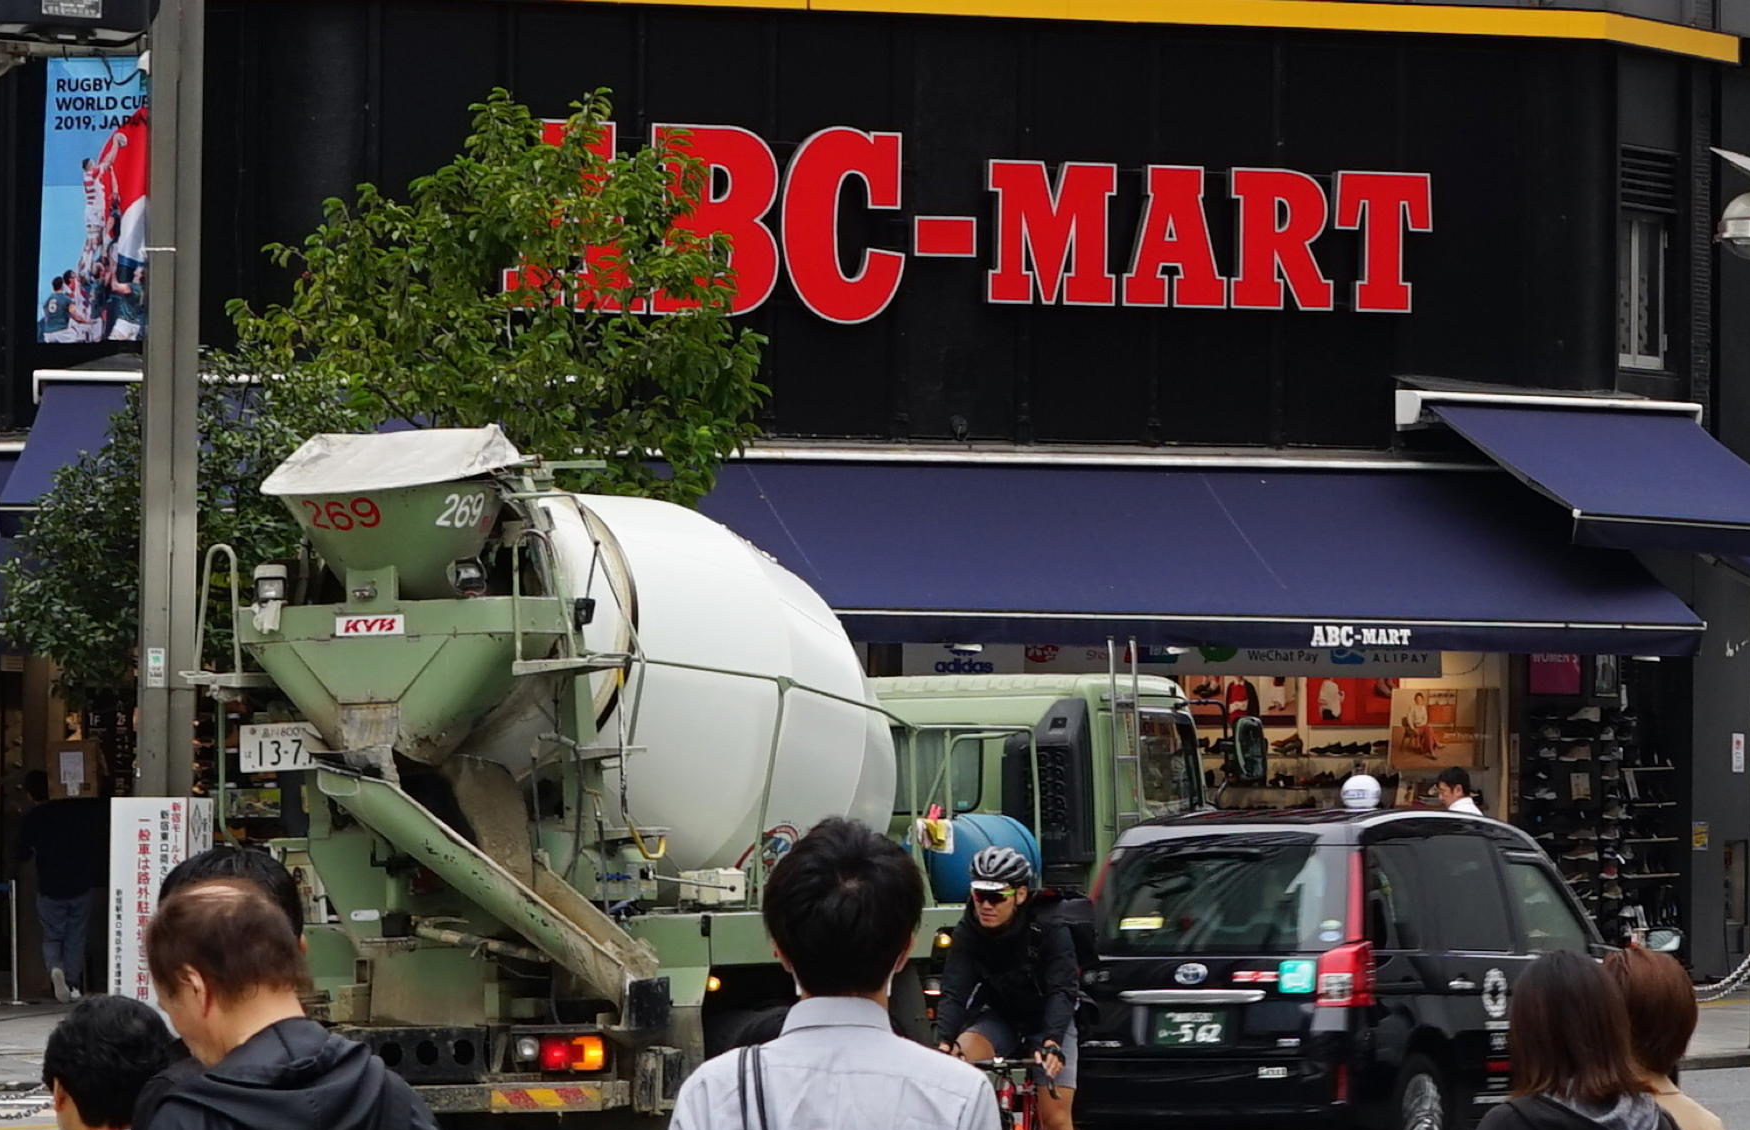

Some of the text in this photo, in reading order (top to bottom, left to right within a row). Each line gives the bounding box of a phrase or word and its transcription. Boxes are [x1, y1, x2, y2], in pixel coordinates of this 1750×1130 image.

[56, 78, 112, 92] RUGBY
[56, 96, 118, 111] WORLD
[54, 115, 96, 132] 2019,
[503, 118, 1433, 325] ABC-MART
[302, 497, 382, 531] 269
[435, 492, 486, 529] 269
[1310, 625, 1412, 648] ABC-MART
[935, 656, 994, 675] adidas
[1247, 648, 1320, 666] WeChat Pay
[1373, 652, 1429, 664] ALIPAY
